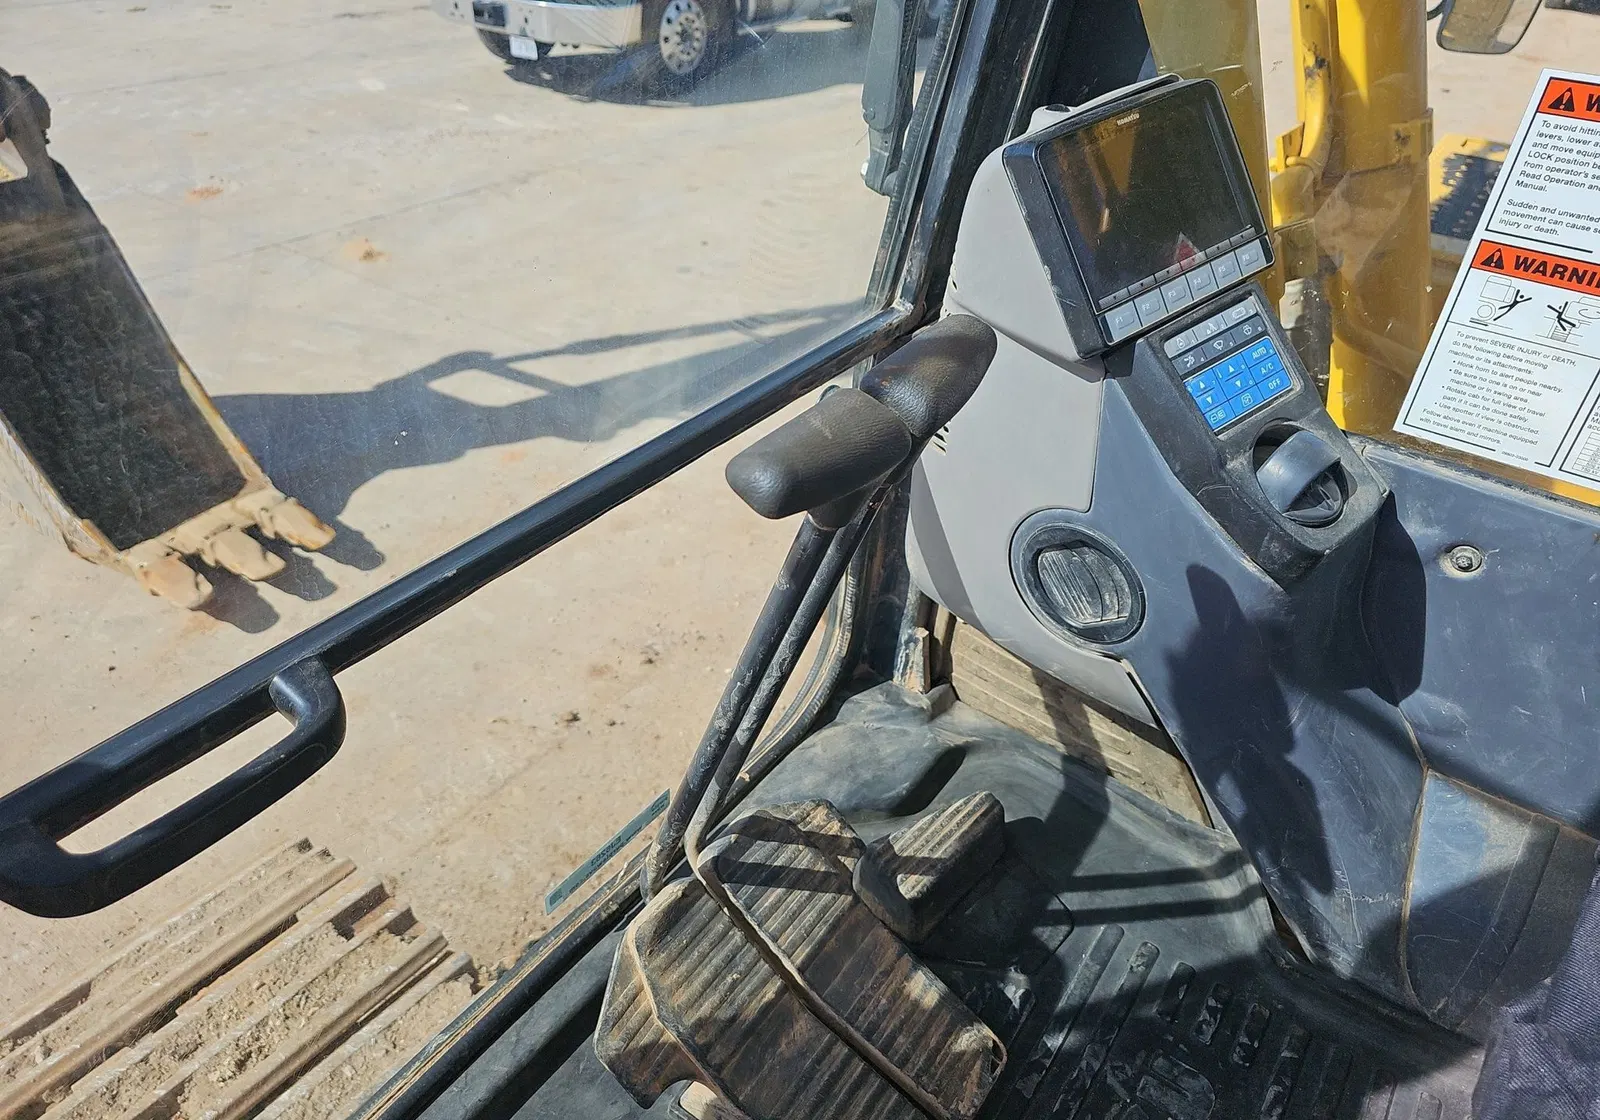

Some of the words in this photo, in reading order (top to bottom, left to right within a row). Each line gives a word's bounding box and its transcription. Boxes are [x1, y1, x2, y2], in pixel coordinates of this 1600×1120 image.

[1553, 124, 1578, 132] avoid
[1536, 130, 1564, 142] levers,
[1567, 136, 1592, 145] lower
[1550, 145, 1574, 154] move
[1528, 151, 1554, 161] LOCK
[1554, 157, 1590, 167] position
[1524, 161, 1543, 170] from
[1546, 166, 1589, 178] operator's
[1515, 180, 1548, 192] Manual.
[1519, 170, 1542, 180] Read
[1544, 175, 1586, 188] Operation
[1507, 199, 1538, 211] Sudden
[1499, 218, 1522, 228] injury
[1534, 226, 1560, 236] death.
[1503, 210, 1546, 222] movement
[1566, 222, 1591, 232] cause
[1514, 254, 1600, 288] WARNI
[1448, 350, 1474, 359] machine
[1465, 334, 1489, 343] prevent
[1490, 340, 1516, 350] SEVERE
[1517, 346, 1542, 356] INJURY
[1551, 355, 1576, 367] DEATH,
[1473, 345, 1501, 357] following
[1502, 353, 1523, 362] before
[1524, 359, 1548, 370] moving
[1261, 363, 1274, 374] A/C
[1457, 361, 1473, 369] Honk
[1514, 376, 1538, 386] people
[1268, 379, 1281, 390] OFF
[1446, 386, 1466, 395] Rotate
[1450, 378, 1476, 388] machine
[1493, 390, 1512, 399] swing
[1452, 407, 1475, 416] spotter
[1423, 408, 1442, 418] Follow
[1482, 426, 1508, 436] machine
[1508, 434, 1538, 445] equipped
